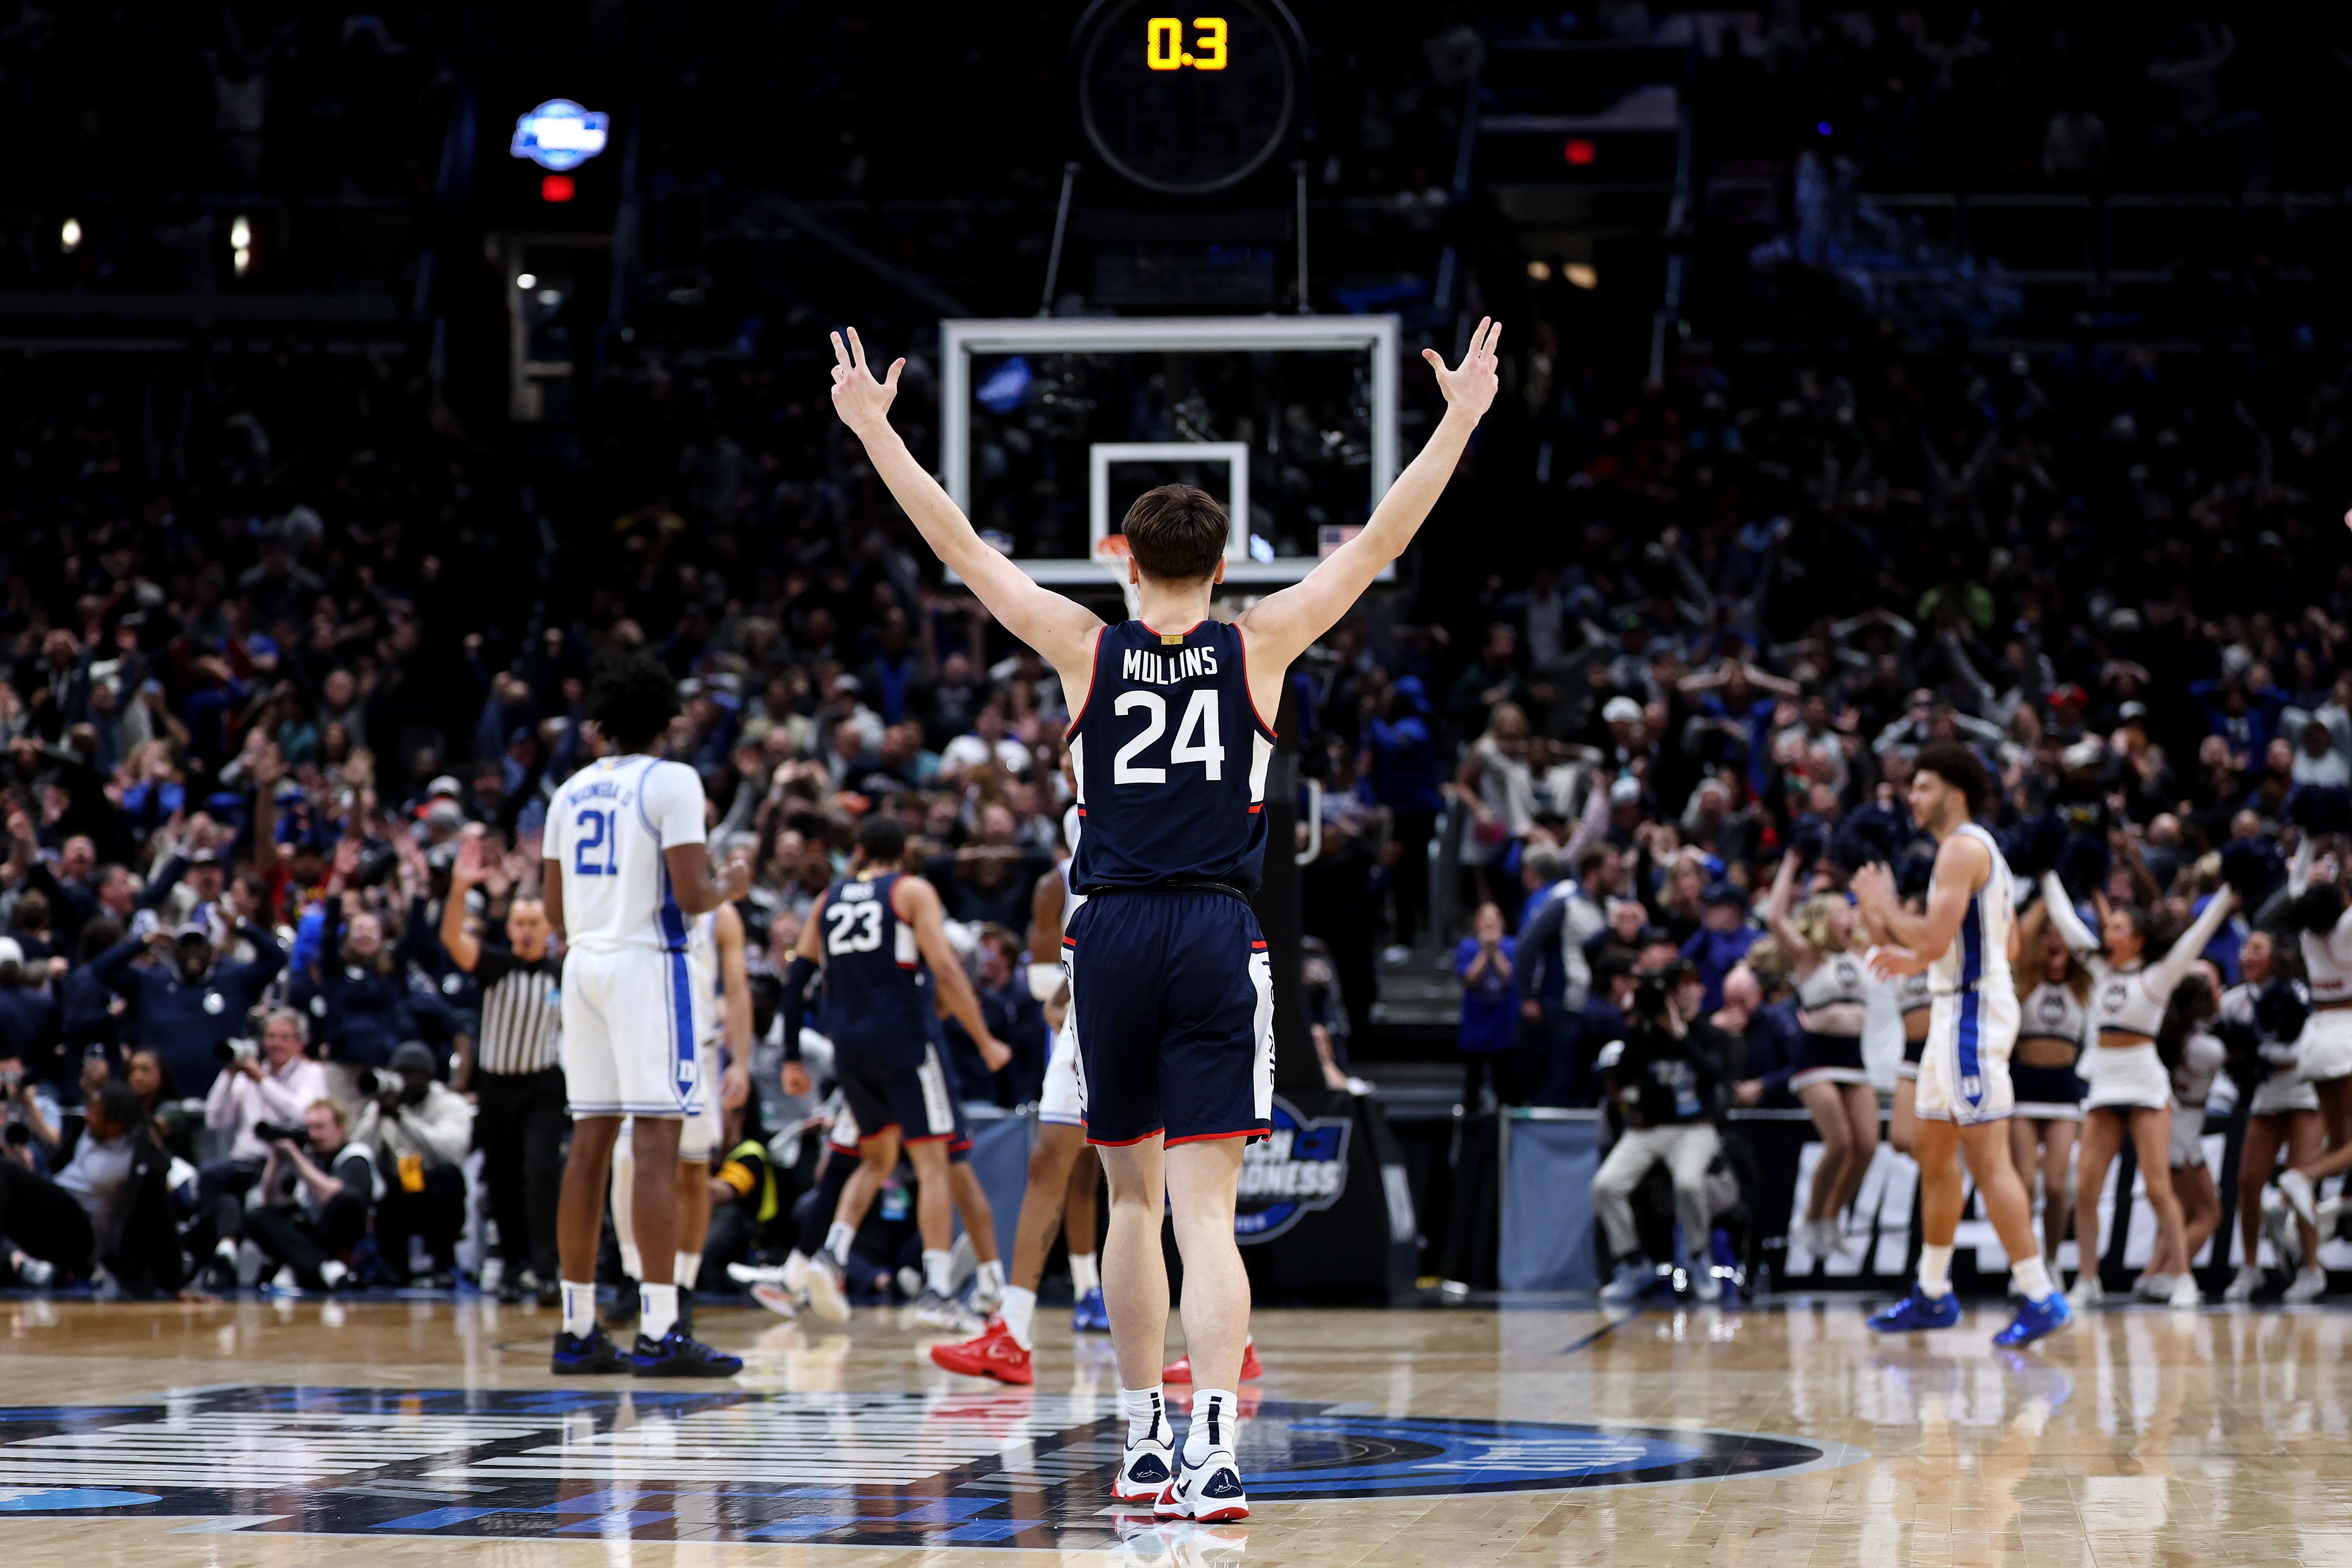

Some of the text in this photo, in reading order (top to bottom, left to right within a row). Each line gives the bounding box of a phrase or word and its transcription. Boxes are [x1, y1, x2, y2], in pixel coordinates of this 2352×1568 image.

[1148, 18, 1227, 70] 0.3
[1123, 646, 1218, 685] MULLINS
[1114, 689, 1225, 785] 24
[575, 810, 618, 875] 21
[825, 899, 883, 956] 23
[1238, 1160, 1341, 1195] DNESS
